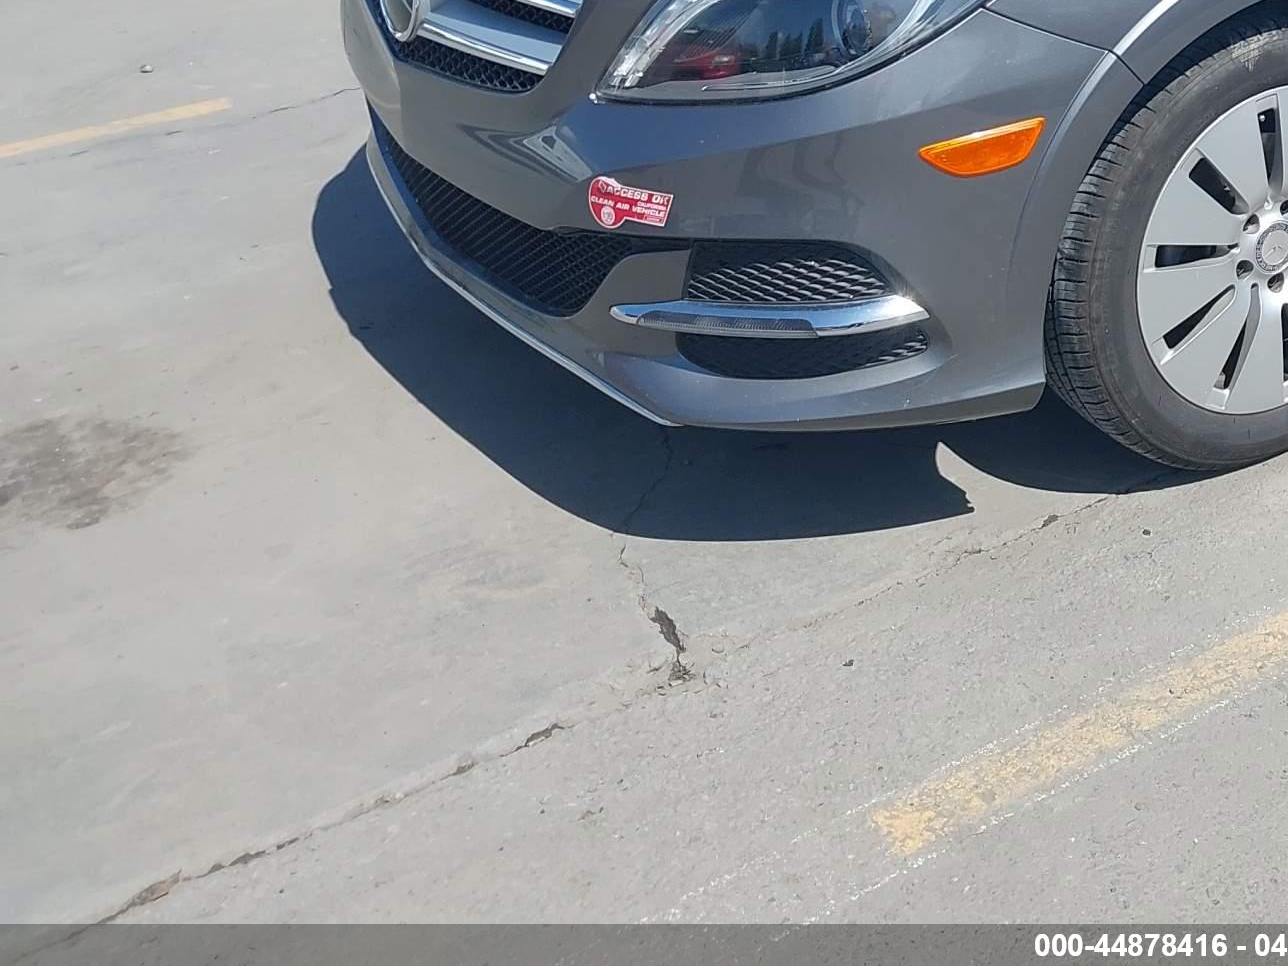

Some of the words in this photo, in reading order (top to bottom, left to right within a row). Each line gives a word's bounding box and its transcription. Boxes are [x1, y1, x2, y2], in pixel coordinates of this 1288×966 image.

[590, 195, 615, 207] CLEAN
[615, 201, 631, 211] AIR
[632, 205, 666, 218] VEHICLE
[606, 185, 649, 202] ACCESS
[651, 194, 669, 206] OK
